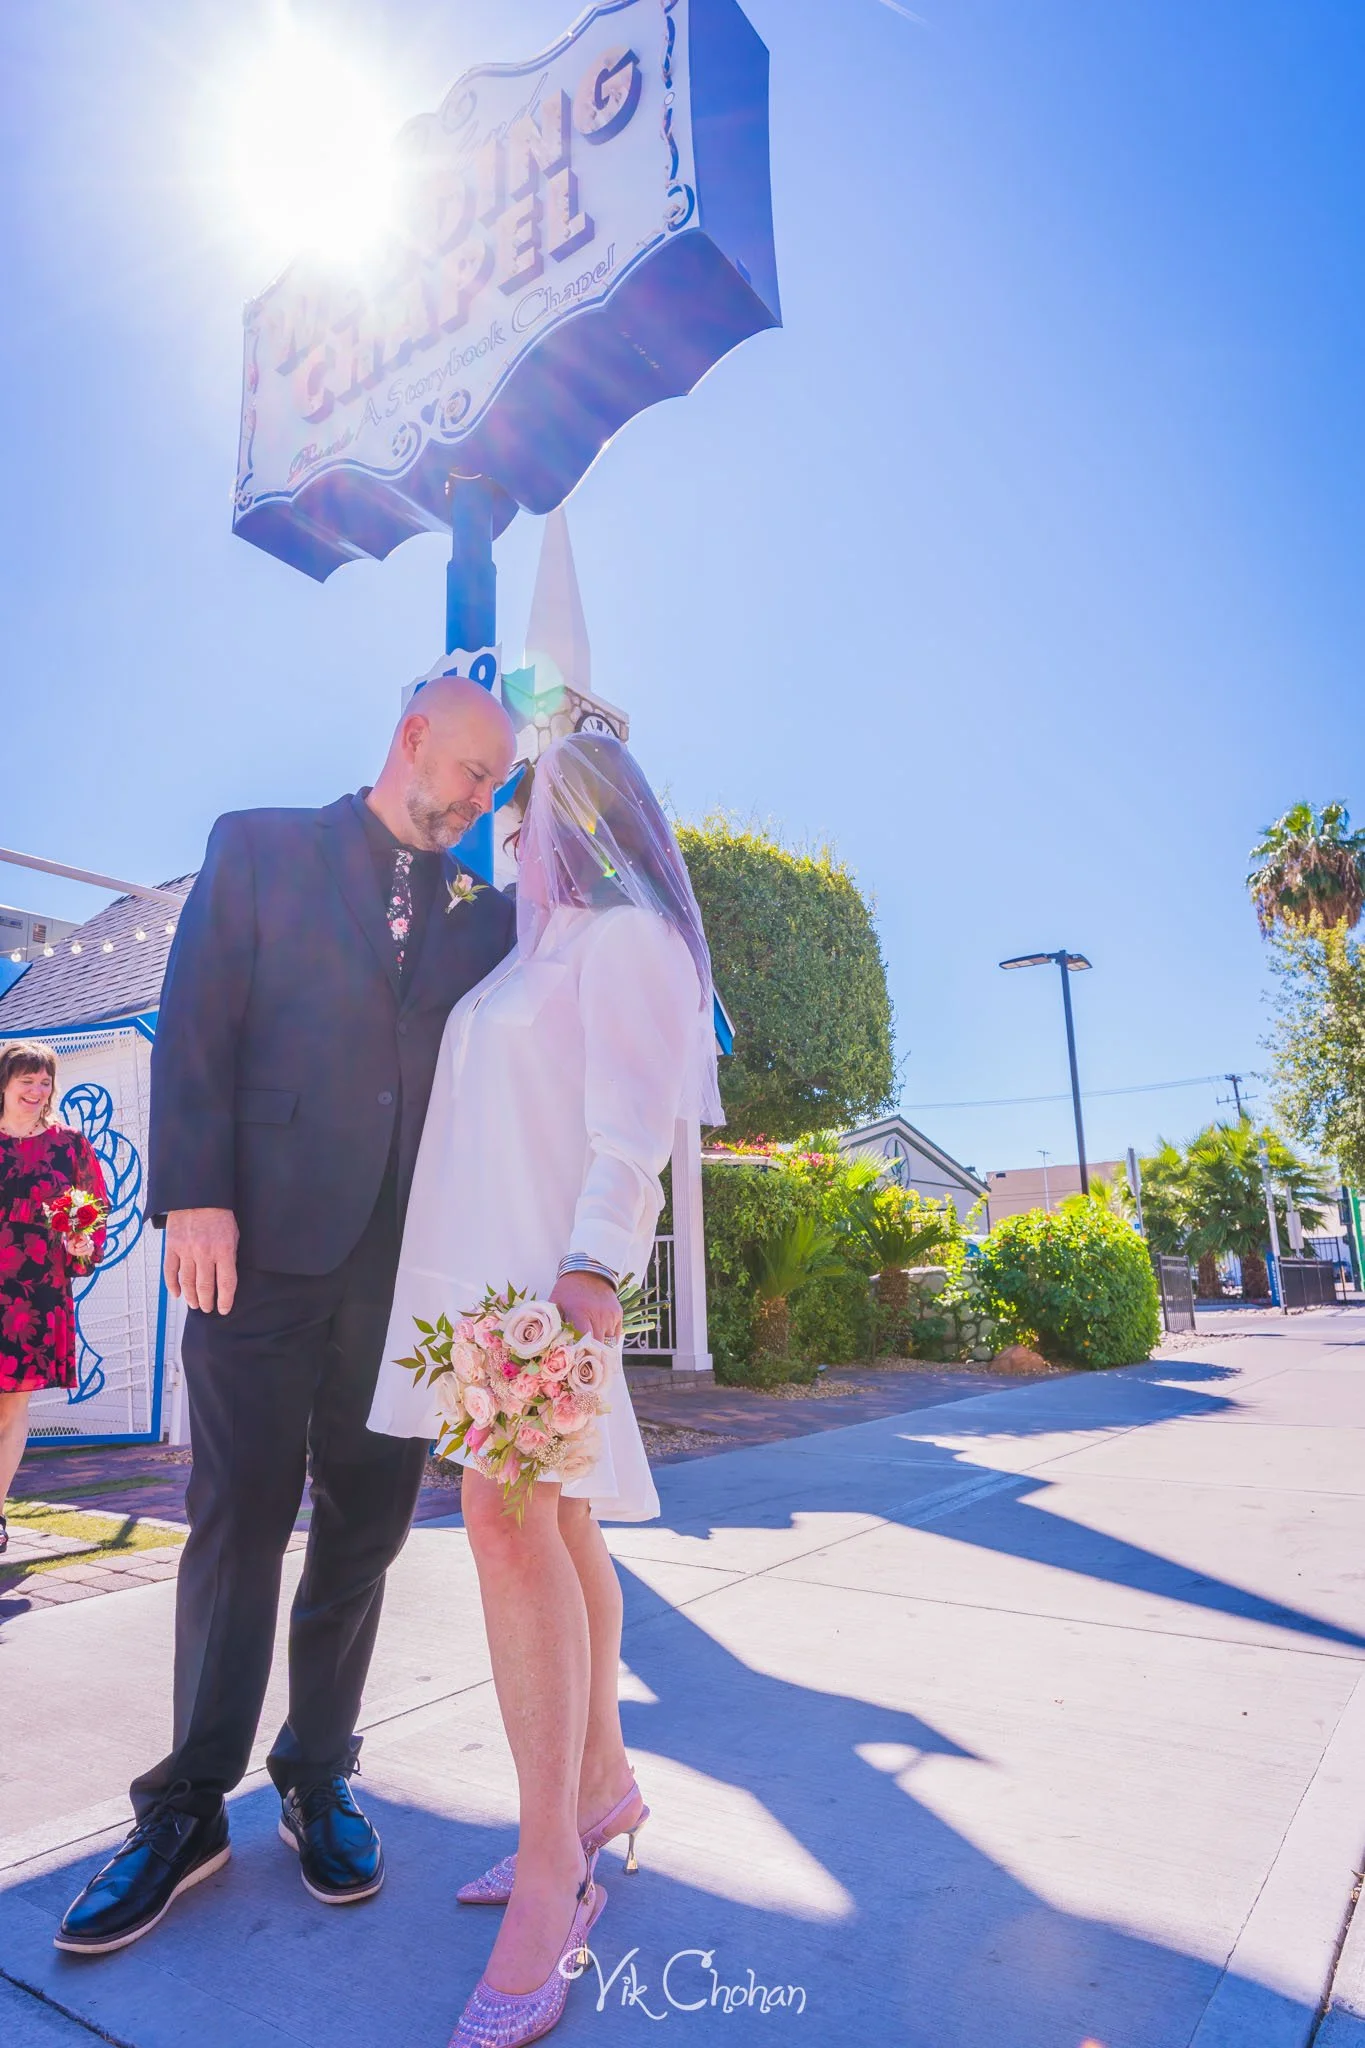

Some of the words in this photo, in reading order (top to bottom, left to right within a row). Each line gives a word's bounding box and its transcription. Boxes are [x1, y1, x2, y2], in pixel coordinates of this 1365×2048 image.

[292, 165, 596, 425] CHAPEL
[355, 396, 383, 441] A
[386, 320, 507, 418] Storybook
[512, 242, 616, 333] Chapel
